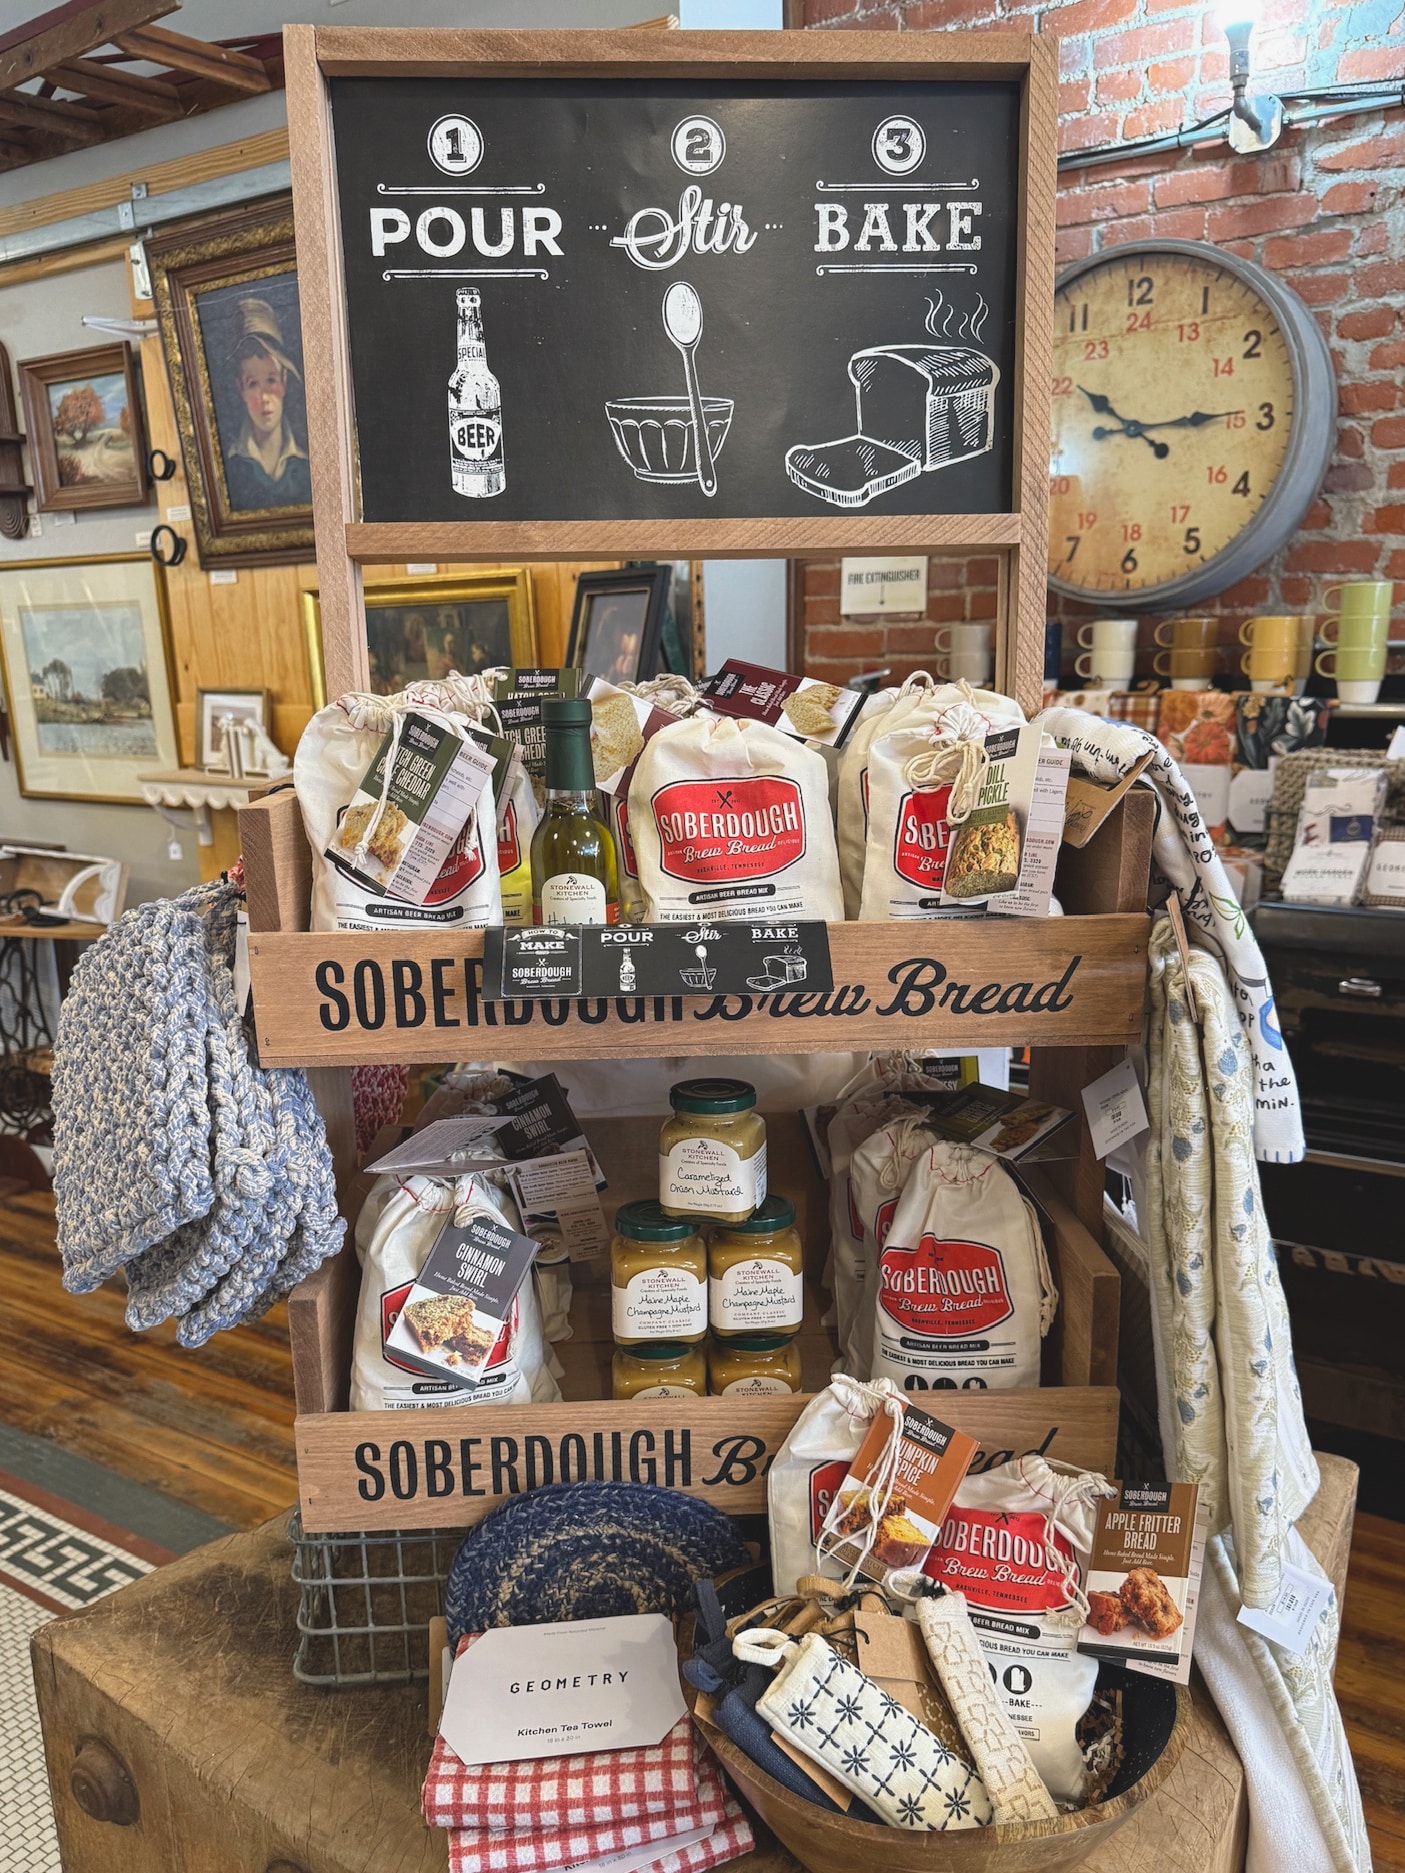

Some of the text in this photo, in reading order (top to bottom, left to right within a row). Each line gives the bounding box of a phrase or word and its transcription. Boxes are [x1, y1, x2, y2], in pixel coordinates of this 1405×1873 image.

[446, 127, 466, 163] 1
[685, 127, 711, 164] 2
[886, 128, 911, 164] 3
[369, 206, 565, 257] POUR
[608, 184, 759, 270] Stir
[813, 201, 983, 252] BAKE
[1128, 276, 1154, 307] 12
[1202, 286, 1209, 315] 1
[1069, 303, 1088, 333] 11
[1126, 311, 1151, 333] 24
[1177, 323, 1200, 343] 13
[1084, 339, 1109, 361] 23
[1243, 329, 1262, 359] 2
[1212, 357, 1234, 378] 14
[1051, 377, 1073, 396] 22
[1225, 410, 1246, 430] 15
[1256, 402, 1274, 431] 3
[458, 424, 494, 448] BEER
[1207, 466, 1228, 484] 16
[1232, 471, 1250, 498] 4
[1078, 512, 1097, 531] 19
[1170, 505, 1190, 524] 17
[1122, 523, 1142, 542] 18
[1183, 528, 1201, 555] 5
[1066, 536, 1081, 562] 7
[1121, 548, 1138, 574] 6
[848, 569, 920, 585] FIRE EXTINGUISHER
[518, 675, 556, 684] SOBERDOUGH
[501, 706, 540, 718] SOBERDOUGH
[408, 725, 440, 749] SOBERDOUGH
[410, 755, 437, 782] GREEN
[471, 757, 488, 771] GUIDE
[1046, 758, 1063, 766] GUIDE
[395, 768, 431, 800] CHEDDAR
[986, 763, 1005, 785] DILL
[978, 782, 1009, 806] PICKLE
[660, 801, 799, 844] SOBERDOUGH
[683, 835, 777, 864] Brew Bread
[731, 862, 765, 870] TENNESSEE
[695, 893, 718, 902] ARTISAN
[719, 890, 735, 899] BEER
[736, 888, 758, 897] BREAD
[373, 907, 446, 921] ARTISAN BEER BREAD
[505, 909, 521, 918] MAKE
[660, 913, 671, 921] THE
[672, 912, 695, 920] EASIEST
[702, 910, 717, 920] MOST
[718, 906, 746, 918] DELICIOUS
[747, 904, 765, 914] BREAD
[766, 904, 777, 913] YOU
[777, 903, 788, 911] CAN
[788, 901, 803, 910] MAKE
[601, 931, 654, 944] POUR
[681, 926, 723, 944] Stir
[751, 927, 799, 939] BAKE
[520, 941, 565, 951] MAKE
[512, 966, 572, 978] SOBERDOUGH
[877, 954, 1083, 1017] Bread
[925, 1064, 959, 1073] SOBERDOUGH
[1259, 1075, 1291, 1092] the
[511, 1103, 553, 1132] CINNAMON
[523, 1120, 552, 1140] SWIRL
[682, 1148, 725, 1156] STONEWALL
[677, 1166, 732, 1187] Caramelized
[669, 1182, 744, 1196] Onion Mustard
[470, 1224, 512, 1249] SOBERDOUGH
[455, 1242, 506, 1277] CINNAMON
[456, 1262, 489, 1289] SWIRL
[881, 1264, 1001, 1297] SOBERDOUGH
[638, 1293, 691, 1305] Maine Maple
[733, 1285, 785, 1297] Maine Maple
[626, 1302, 701, 1320] Champagne Mustard
[722, 1294, 796, 1312] Champagne Mustard
[898, 1294, 984, 1313] Brew Bread
[931, 1342, 968, 1350] BEER BREAD
[912, 1357, 927, 1366] MOST
[928, 1359, 957, 1367] DELICIOUS
[957, 1358, 976, 1367] BREAD
[976, 1358, 988, 1366] YOU
[988, 1358, 1000, 1366] CAN
[1000, 1357, 1015, 1365] MAKE
[486, 1376, 499, 1384] MIX
[426, 1401, 442, 1409] MOST
[444, 1395, 472, 1408] DELICIOUS
[472, 1392, 491, 1401] BREAD
[491, 1389, 503, 1398] YOU
[503, 1386, 513, 1395] CAN
[904, 1415, 947, 1446] SOBERDOUGH
[354, 1429, 691, 1500] SOBERDOUGH
[899, 1440, 939, 1475] UMPKIN
[897, 1459, 924, 1486] PICE
[1124, 1489, 1168, 1502] SOBERDOUGH
[1105, 1512, 1181, 1535] APPLE FRITTER
[1123, 1531, 1157, 1551] BREAD
[942, 1557, 1049, 1588] Brew Bread
[992, 1590, 1028, 1604] TENNESSEE
[972, 1617, 1030, 1636] BEER BREAD MIX
[999, 1644, 1021, 1654] BREAD
[1022, 1648, 1036, 1656] YOU
[1050, 1651, 1069, 1659] MAKE
[510, 1671, 629, 1694] GEOMETRY
[1009, 1698, 1031, 1708] BAKE
[517, 1719, 613, 1737] Kitchen Tea Towel
